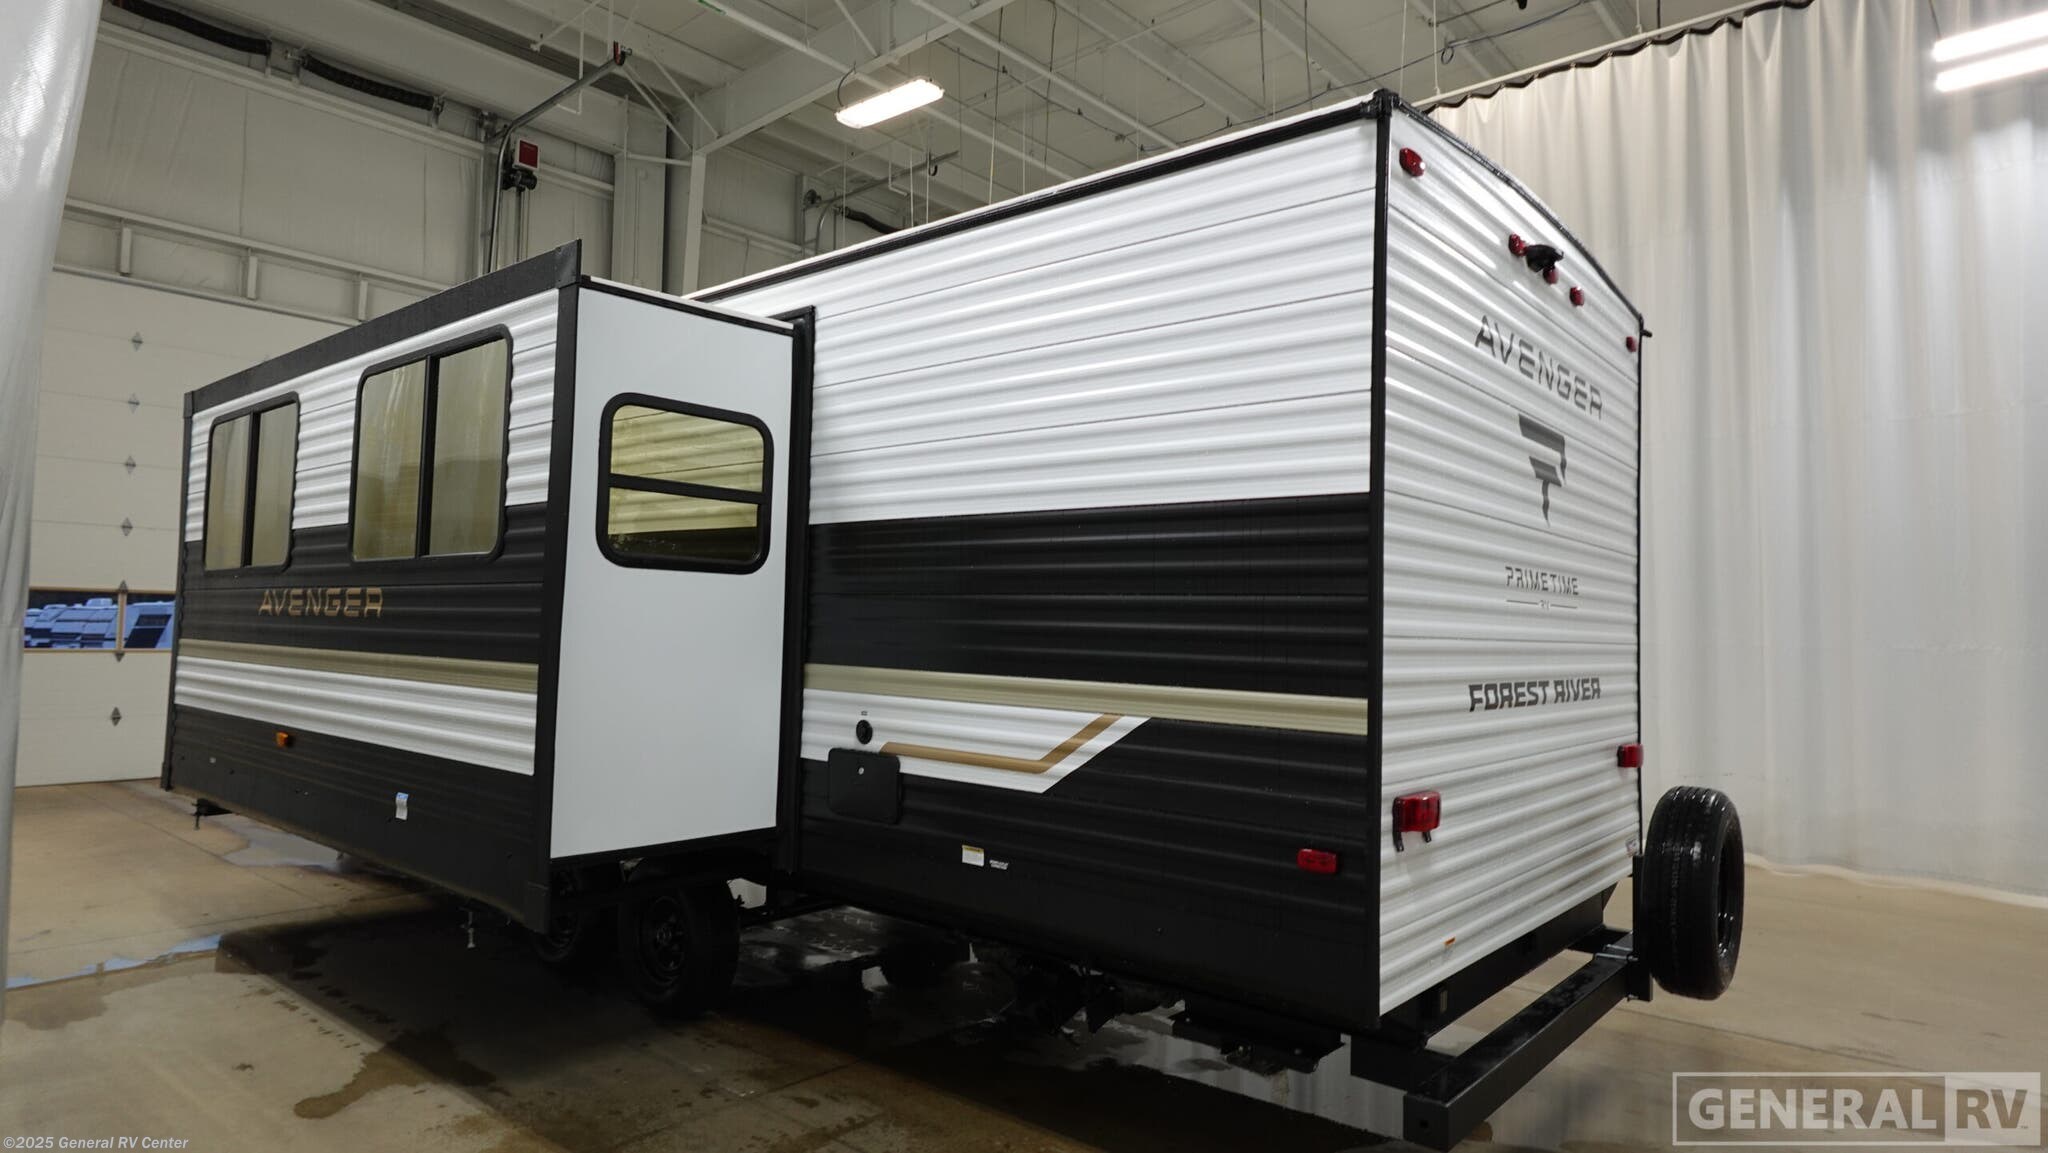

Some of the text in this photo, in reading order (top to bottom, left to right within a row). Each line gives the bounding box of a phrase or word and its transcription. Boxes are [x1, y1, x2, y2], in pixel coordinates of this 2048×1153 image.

[1475, 315, 1602, 420] AVENGER
[258, 587, 383, 617] AVENGER
[1468, 677, 1601, 712] FOREST RIVER
